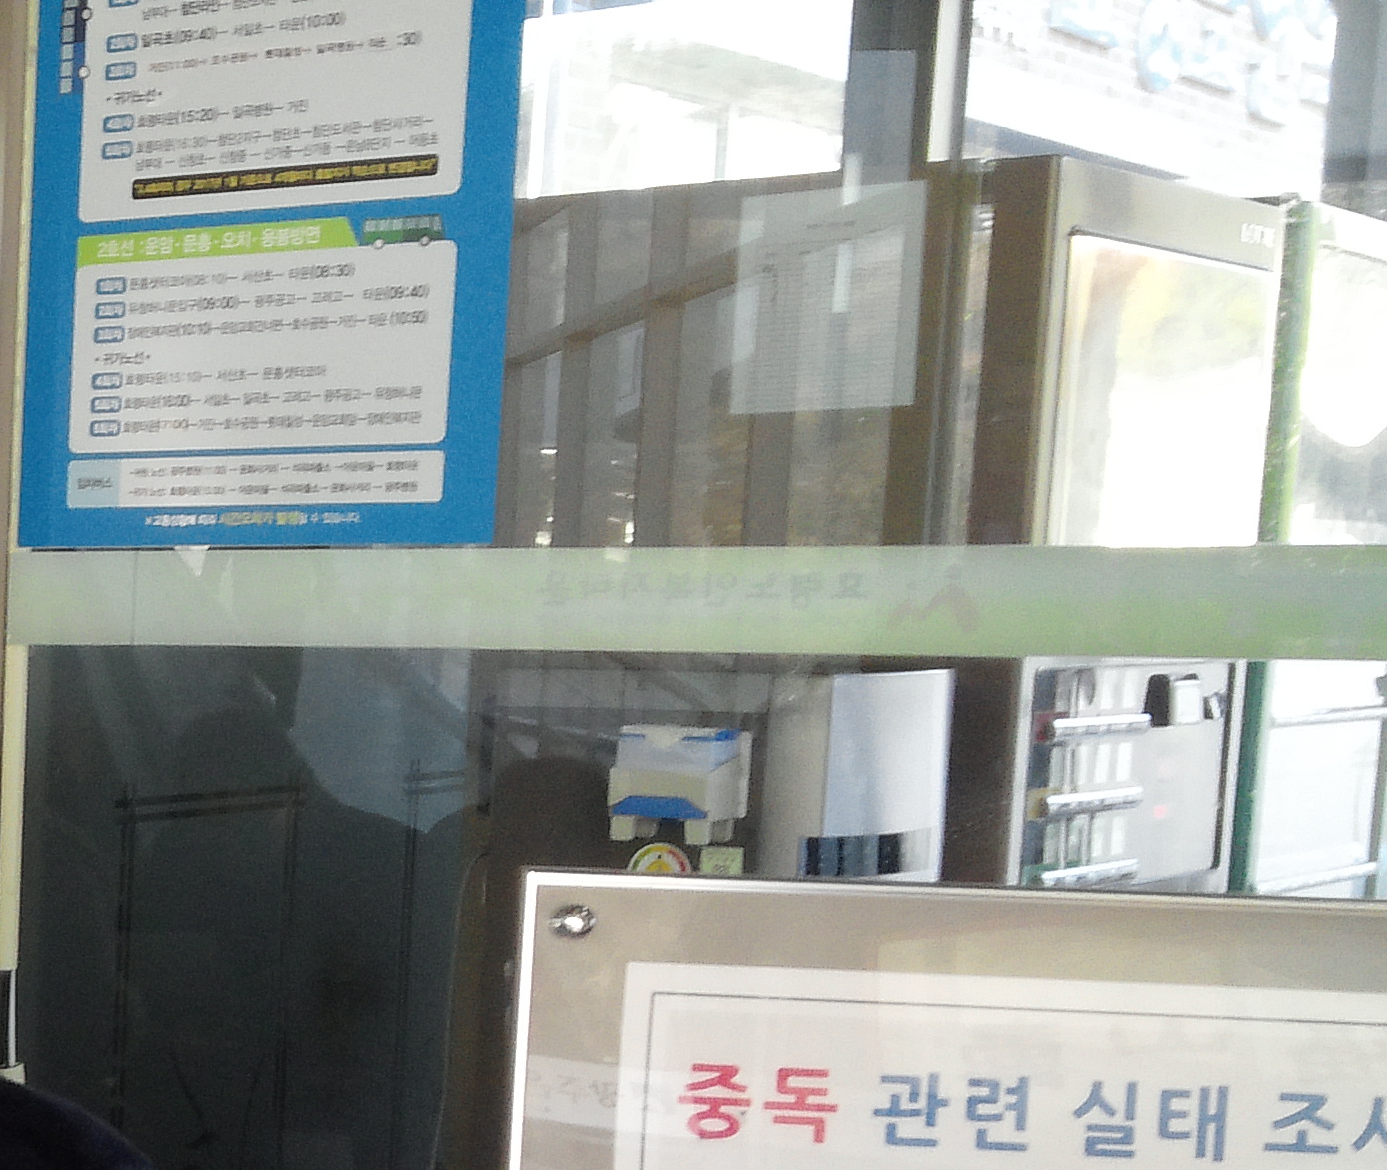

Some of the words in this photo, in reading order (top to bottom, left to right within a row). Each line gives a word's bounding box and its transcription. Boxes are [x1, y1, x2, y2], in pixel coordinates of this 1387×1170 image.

[679, 1064, 838, 1143] 중독
[873, 1074, 1027, 1151] 관련
[1073, 1082, 1228, 1162] 실태
